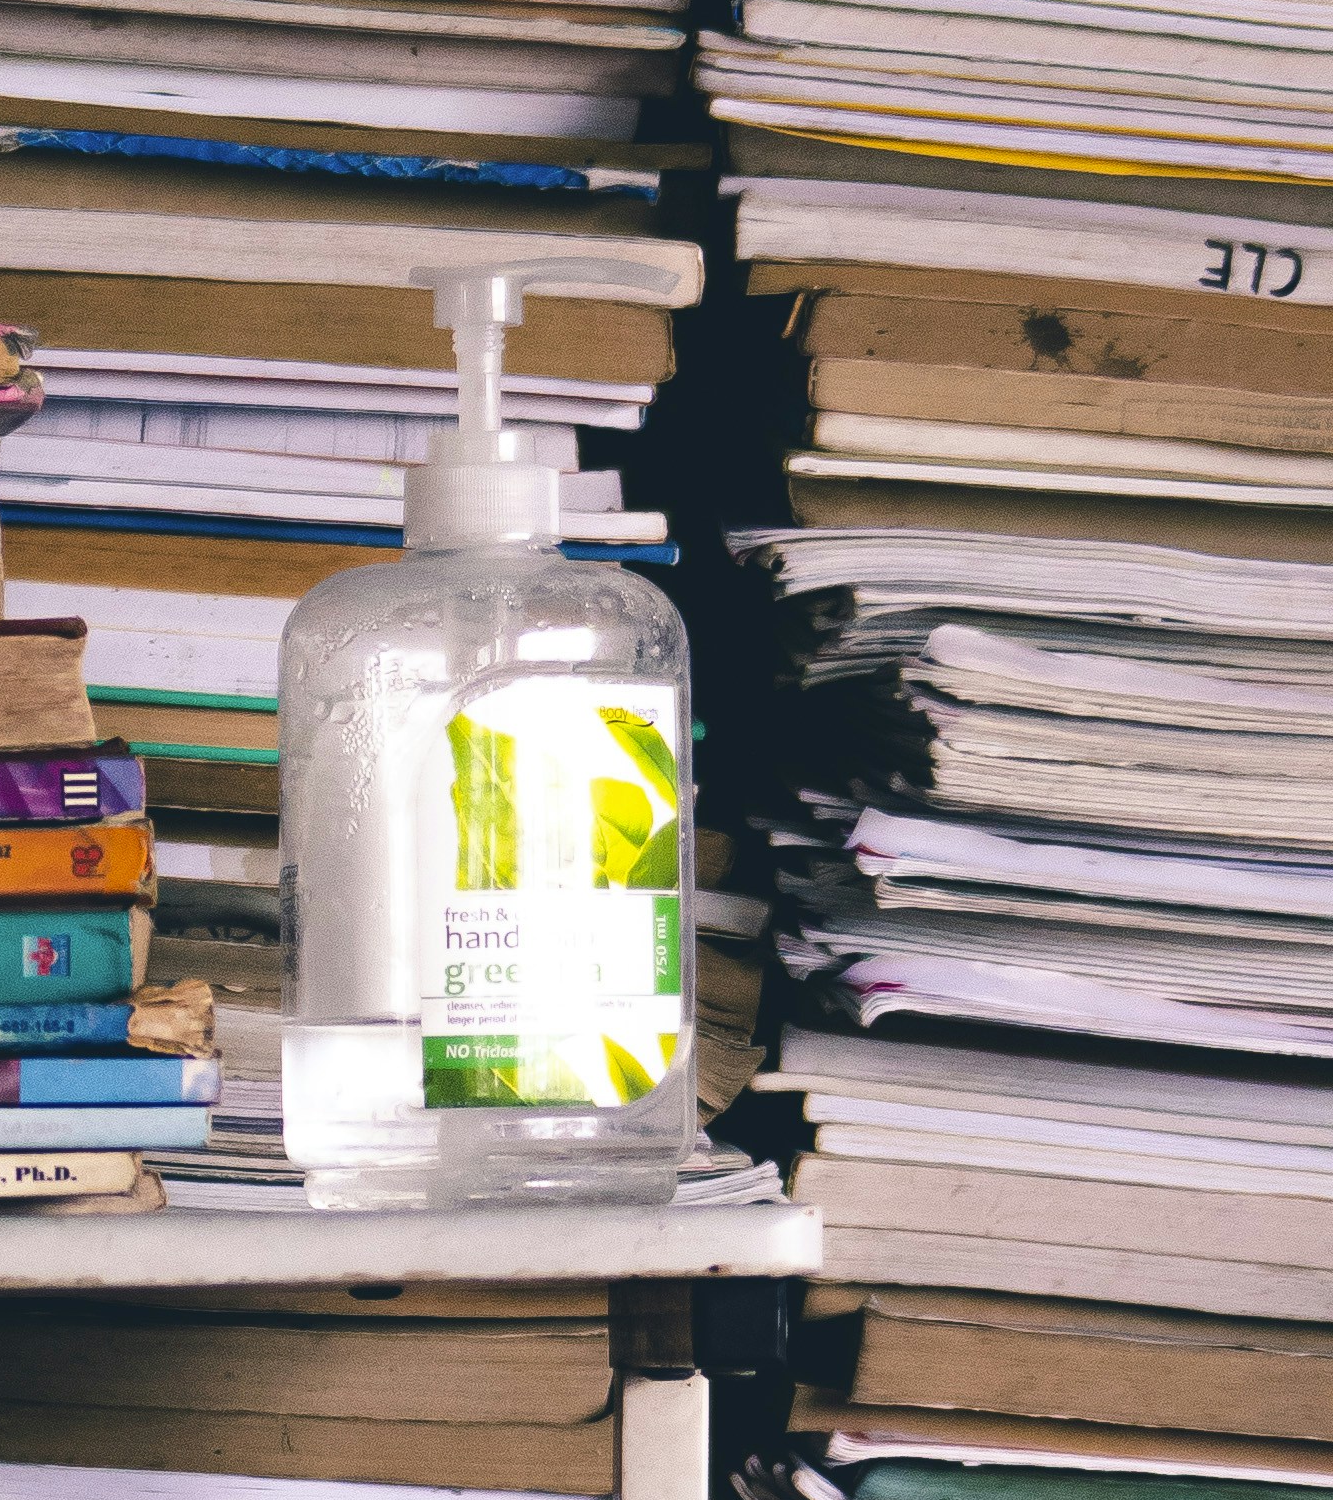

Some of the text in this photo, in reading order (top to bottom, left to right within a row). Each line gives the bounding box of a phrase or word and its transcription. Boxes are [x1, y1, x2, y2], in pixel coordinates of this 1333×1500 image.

[1203, 238, 1304, 299] CLE
[444, 907, 509, 923] fresh &
[445, 924, 520, 950] hand
[655, 913, 668, 977] 750 mL
[443, 961, 525, 997] gree
[446, 1014, 475, 1027] longer
[478, 1014, 506, 1026] period
[445, 1045, 523, 1059] NO Triclos
[16, 1165, 79, 1182] Ph.D.
